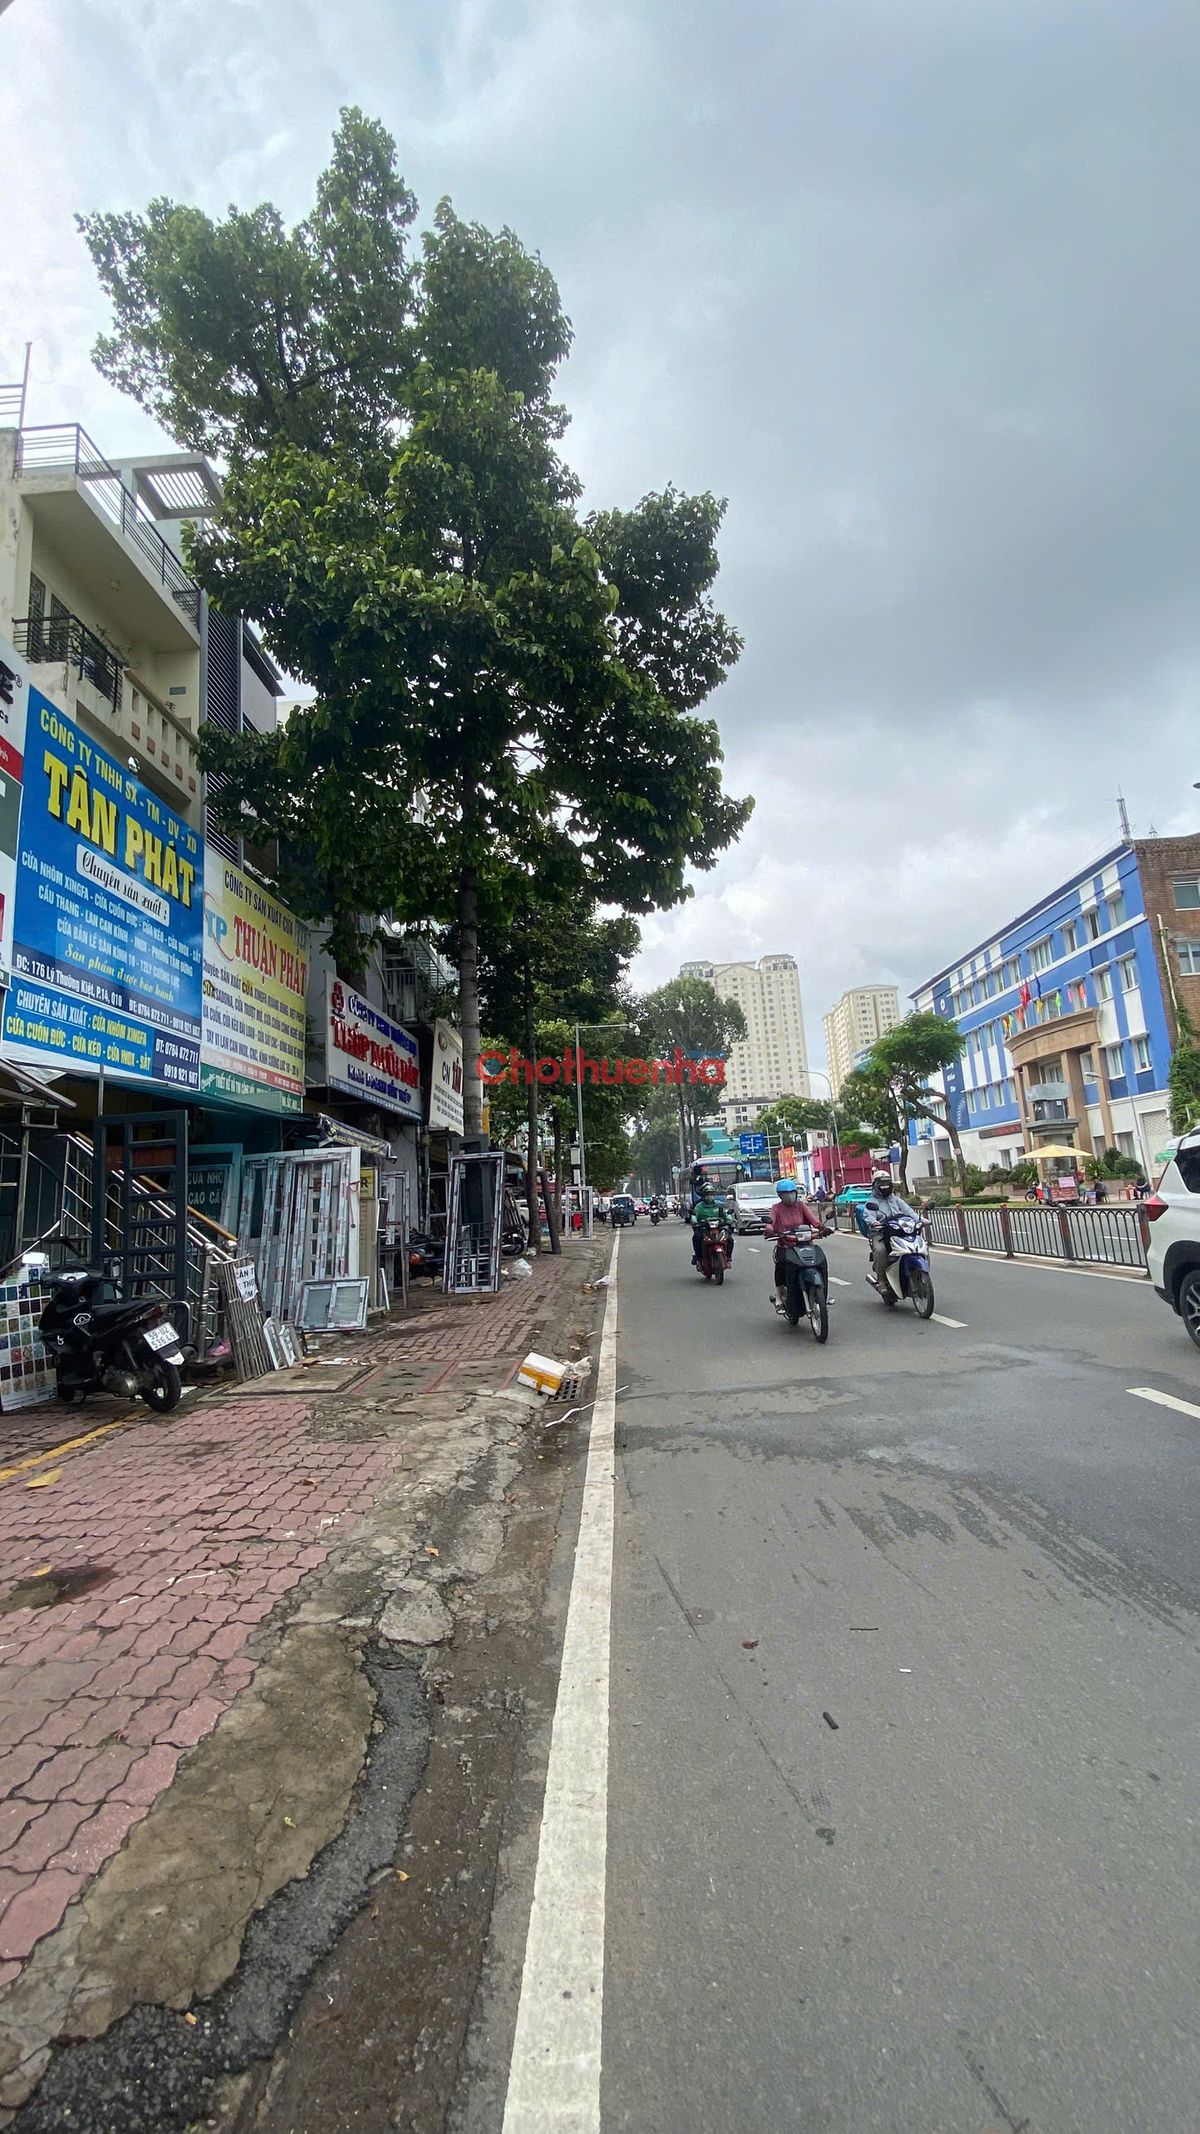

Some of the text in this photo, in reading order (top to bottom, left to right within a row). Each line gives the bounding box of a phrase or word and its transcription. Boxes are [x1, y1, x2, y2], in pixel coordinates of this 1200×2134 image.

[41, 709, 197, 854] CÔNG TY TNHH SX TM DV XD
[43, 750, 194, 907] TÂN PHÁT
[21, 849, 39, 873] CỬA
[40, 861, 63, 887] NHÔM
[64, 875, 89, 901] XINGFA
[82, 850, 120, 891] Chuyên
[123, 882, 139, 903] sản
[224, 870, 243, 899] CÔNG
[245, 886, 252, 906] TY
[253, 892, 267, 916] SẢN
[55, 893, 80, 918] THANG
[85, 909, 98, 927] LAN
[99, 917, 113, 935] CAN
[57, 916, 72, 938] CỬA
[206, 907, 228, 944] TP
[31, 960, 45, 978] 176
[46, 965, 56, 983] Lý
[64, 943, 85, 964] Sản
[234, 914, 277, 985] THUẬN
[279, 947, 307, 997] PHÁT
[16, 989, 51, 1015] CHUYÊN
[51, 997, 68, 1021] SẢN
[68, 1005, 88, 1027] XUẤT
[92, 1012, 106, 1033] CỬA
[6, 1012, 25, 1037] CỬA
[26, 1019, 49, 1043] CUỐN
[72, 1032, 87, 1054] CỬA
[87, 1038, 102, 1057] KÉO
[106, 1041, 119, 1063] CỬA
[189, 1050, 199, 1064] 711
